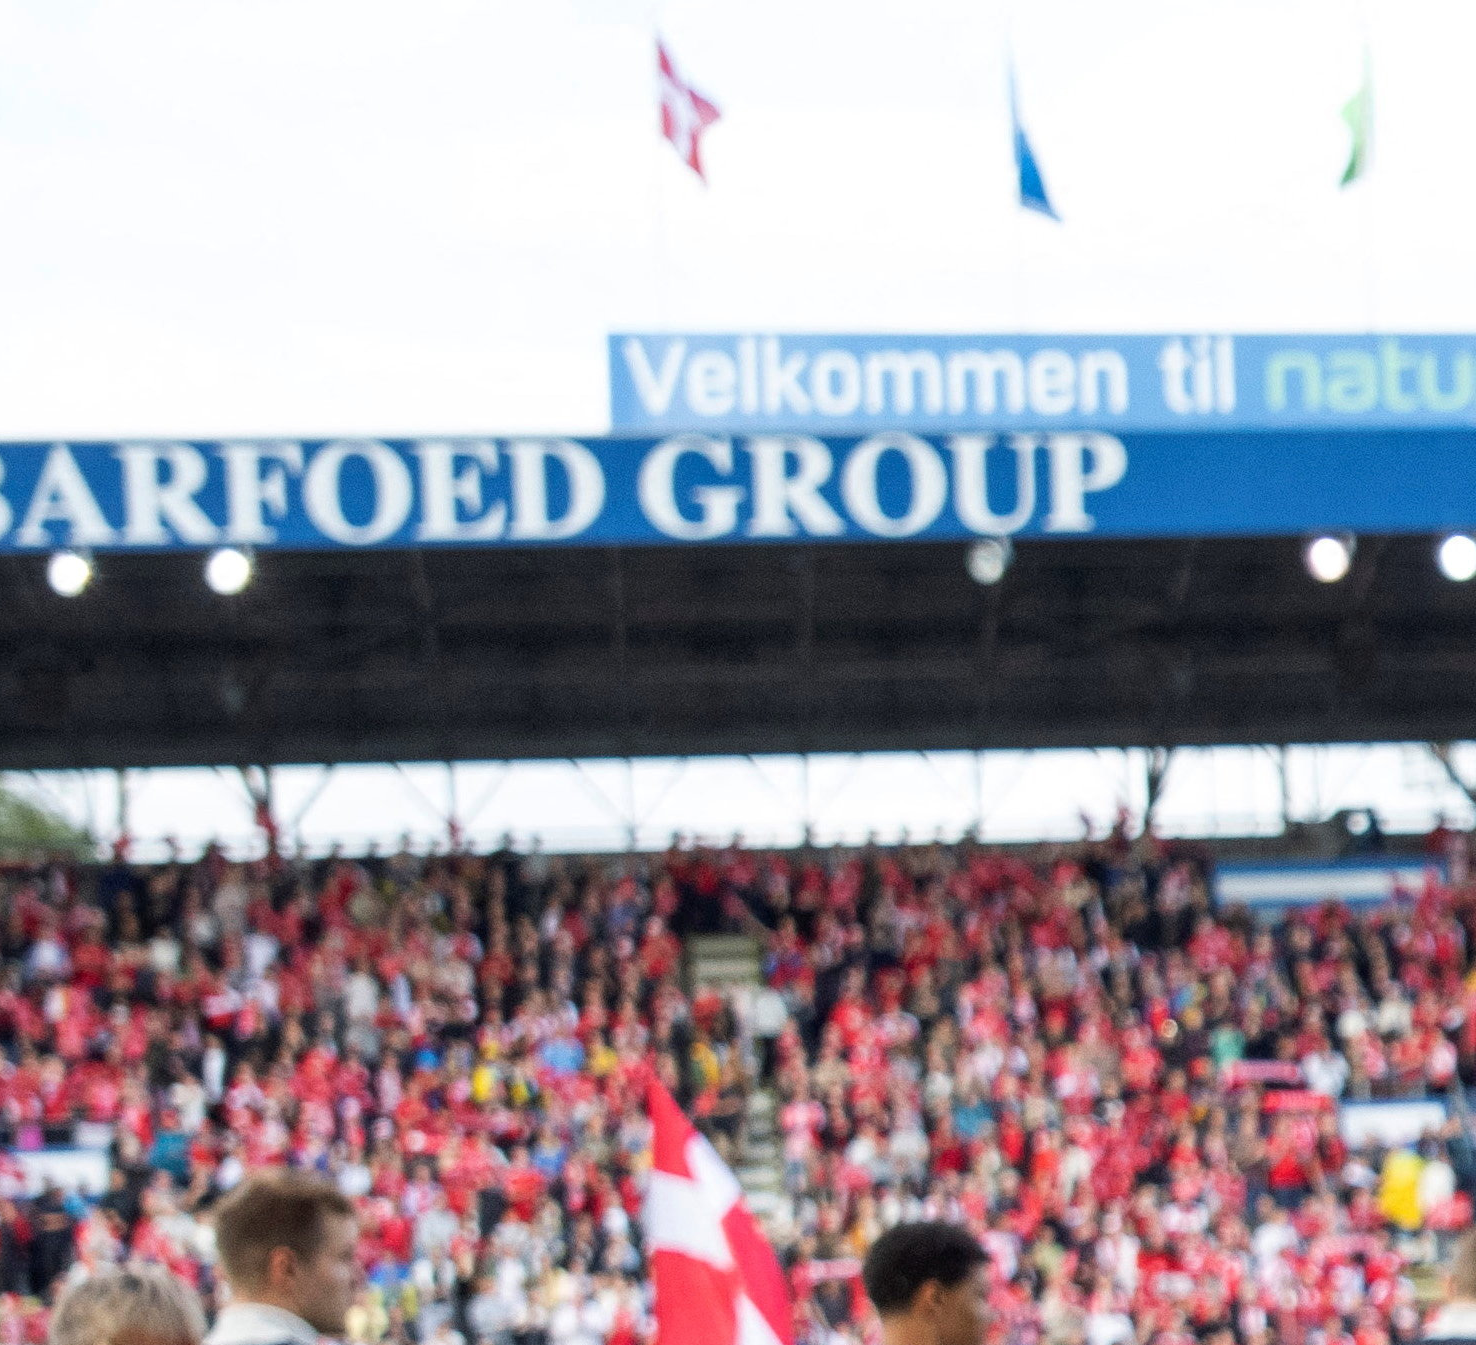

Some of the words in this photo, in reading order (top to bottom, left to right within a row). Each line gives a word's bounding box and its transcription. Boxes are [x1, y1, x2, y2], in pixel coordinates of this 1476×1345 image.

[622, 336, 1129, 415] Velkommen
[1158, 335, 1236, 414] til
[637, 433, 1128, 540] GROUP
